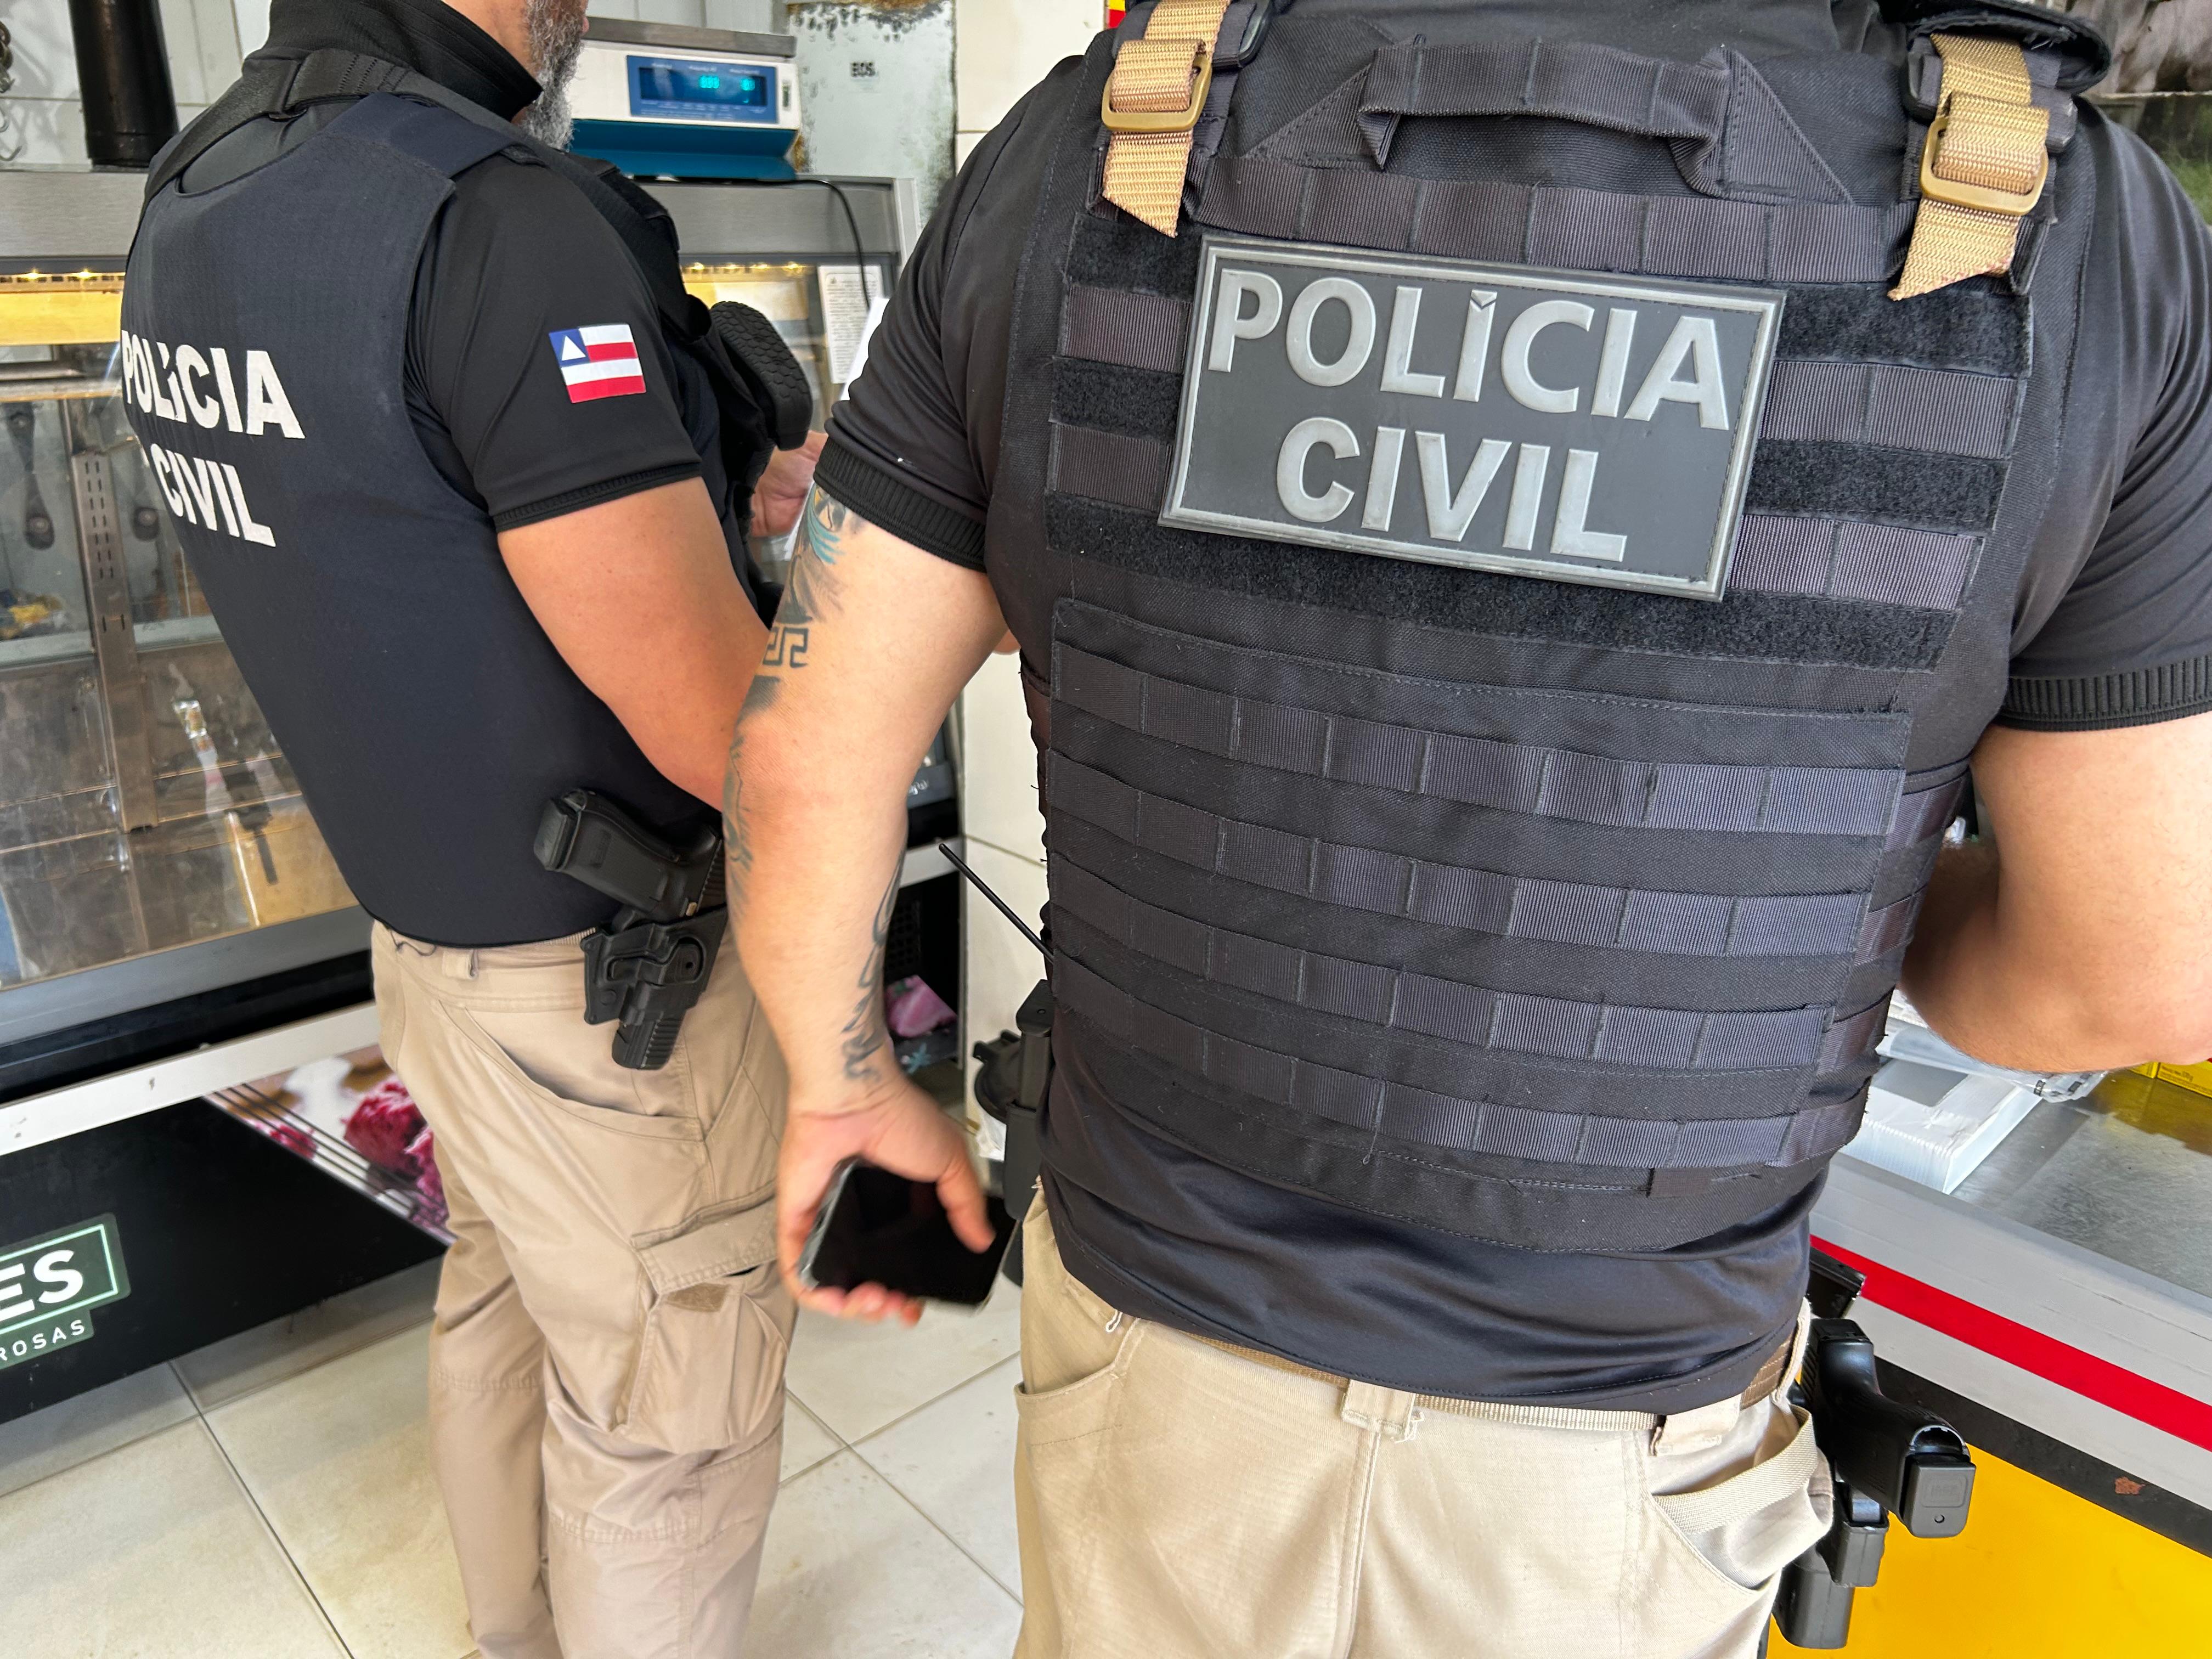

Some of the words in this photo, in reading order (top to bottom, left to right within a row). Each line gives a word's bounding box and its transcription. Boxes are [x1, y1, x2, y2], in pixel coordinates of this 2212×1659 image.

[121, 329, 306, 439] POLÍCIA
[1209, 268, 1729, 431] POLÍCIA
[150, 443, 276, 548] CIVIL
[1276, 416, 1628, 562] CIVIL
